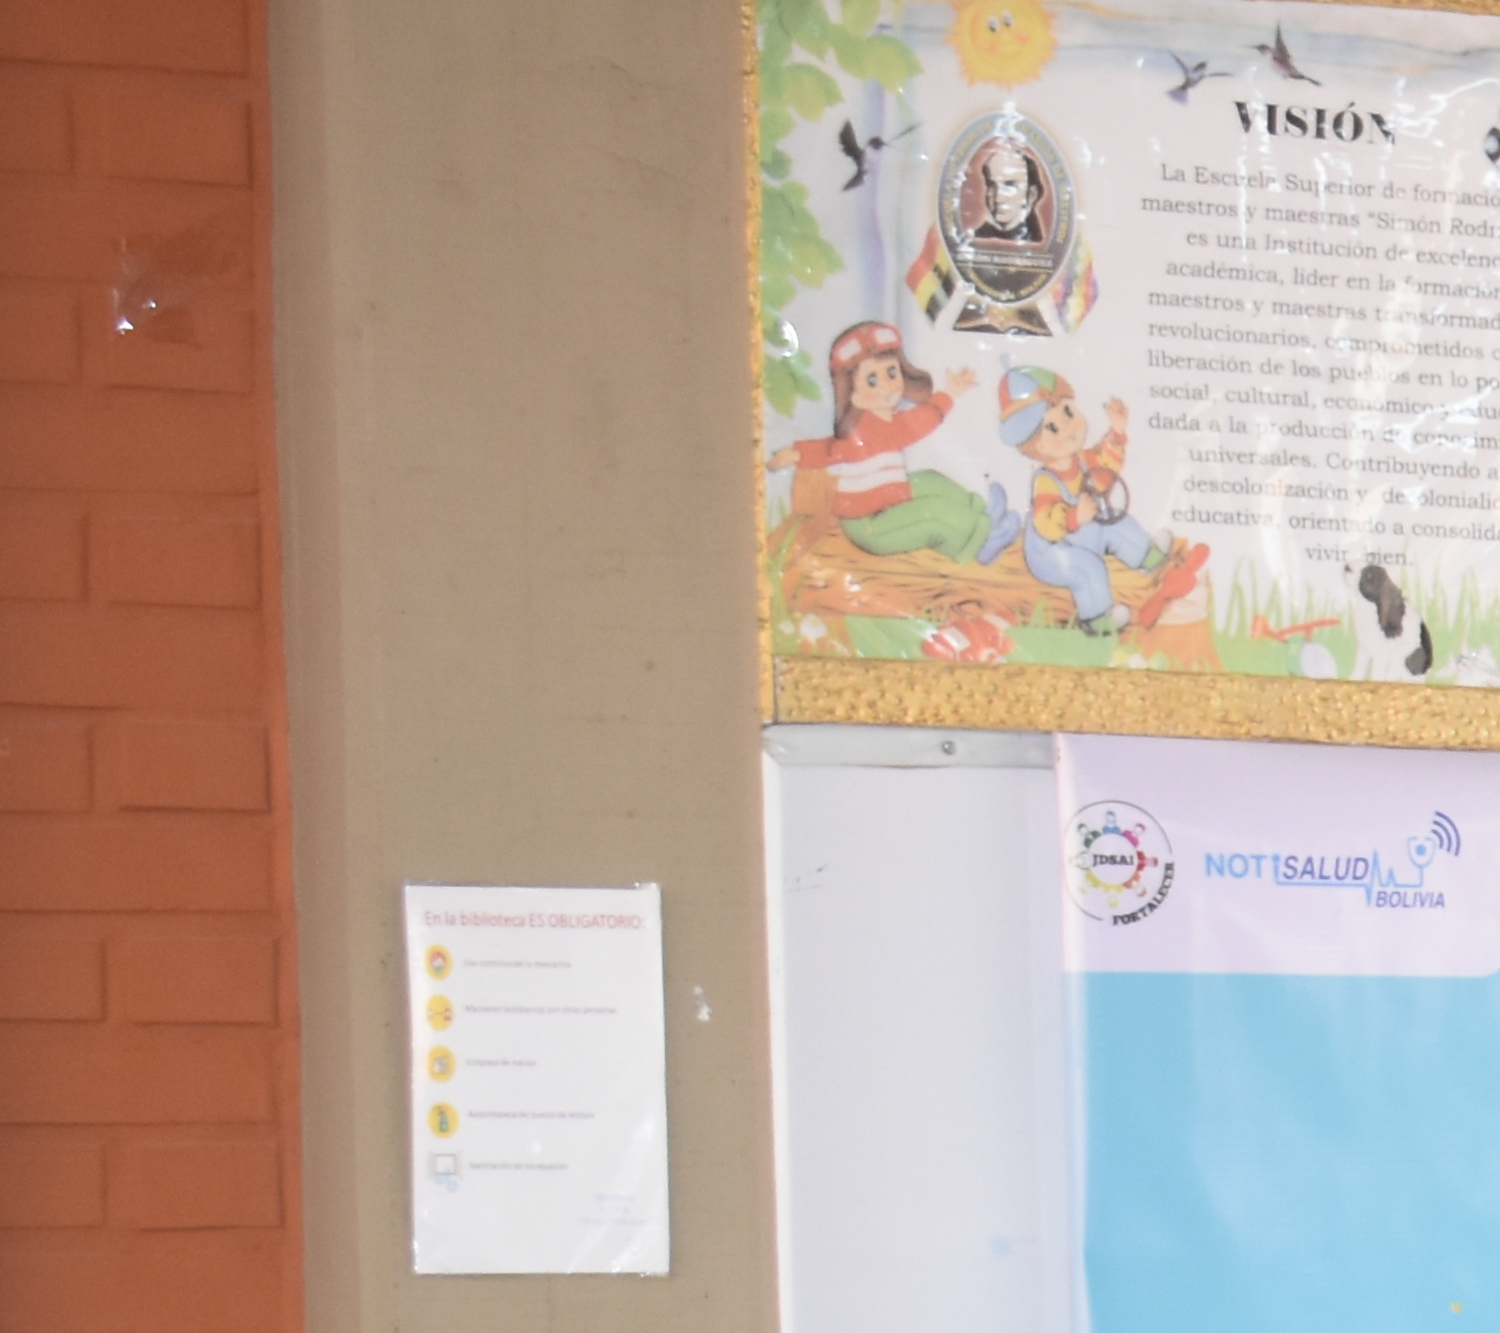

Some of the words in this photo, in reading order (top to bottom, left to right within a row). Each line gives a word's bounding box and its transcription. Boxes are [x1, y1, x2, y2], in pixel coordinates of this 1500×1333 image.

[1233, 99, 1396, 146] VISIÓN
[1161, 163, 1186, 182] La
[1195, 165, 1277, 189] Escuela
[1284, 173, 1375, 199] Superior
[1382, 182, 1405, 199] de
[1141, 197, 1239, 217] maestros
[1245, 206, 1257, 223] y
[1265, 207, 1360, 227] maestras
[1186, 232, 1208, 247] es
[1216, 234, 1256, 250] una
[1265, 234, 1377, 260] Institución
[1385, 245, 1409, 262] de
[1166, 261, 1284, 285] académica,
[1346, 276, 1370, 291] en
[1379, 275, 1395, 292] la
[1148, 291, 1245, 312] maestros
[1252, 300, 1265, 317] y
[1272, 300, 1367, 320] maestras
[1148, 322, 1317, 349] revolucionarios,
[1148, 350, 1252, 374] liberación
[1260, 358, 1284, 375] de
[1292, 360, 1321, 378] los
[1418, 372, 1443, 386] en
[1451, 371, 1468, 388] lo
[1224, 388, 1317, 410] cultural,
[1148, 412, 1201, 431] dada
[1208, 418, 1221, 432] a
[1228, 416, 1248, 433] la
[1188, 448, 1317, 469] universales.
[1326, 451, 1481, 480] Contribuyendo
[1488, 466, 1499, 480] a
[1183, 476, 1348, 501] descolonización
[1357, 489, 1368, 506] y
[1393, 521, 1405, 535] a
[1375, 891, 1445, 908] BOLIVIA
